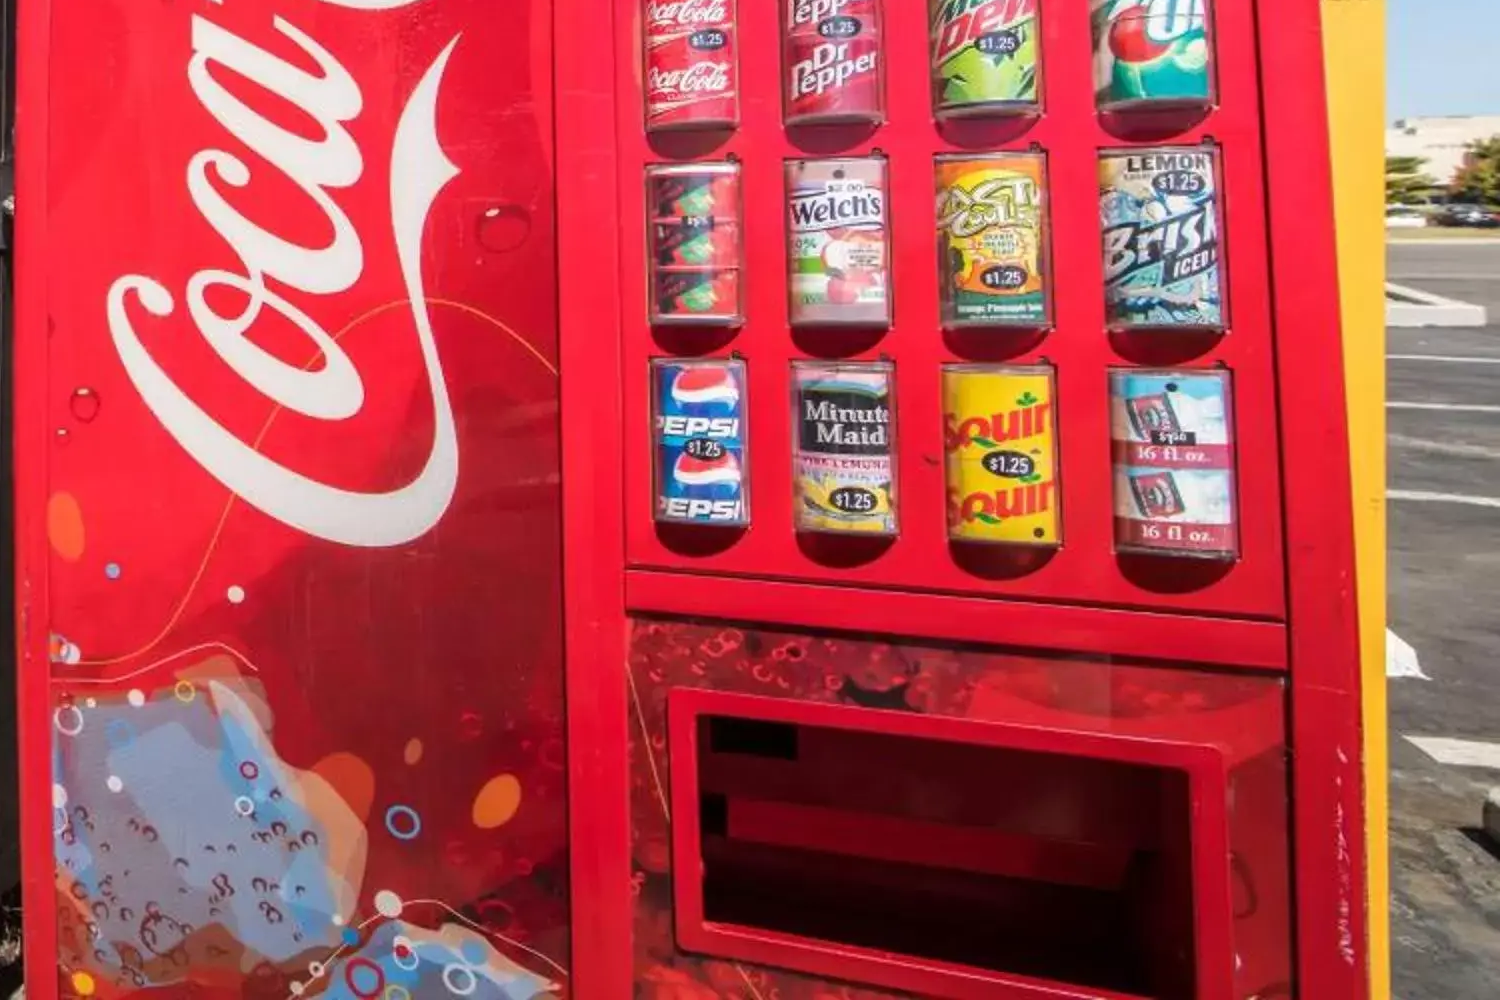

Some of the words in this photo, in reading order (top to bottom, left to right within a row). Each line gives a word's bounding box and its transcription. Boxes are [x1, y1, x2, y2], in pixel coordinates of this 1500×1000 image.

[821, 21, 856, 35] $1.25
[691, 33, 724, 46] $1.25
[979, 36, 1016, 50] $1.25
[813, 42, 849, 71] Dr
[791, 51, 878, 102] Pepper
[1158, 174, 1200, 191] $1.25
[791, 193, 881, 226] Welch's
[985, 271, 1023, 285] $1.25
[815, 422, 886, 446] Maid
[688, 440, 723, 458] $1.25
[1137, 446, 1157, 460] 16
[989, 456, 1030, 474] $1.25
[835, 492, 872, 509] $1.25
[1142, 525, 1161, 539] 16
